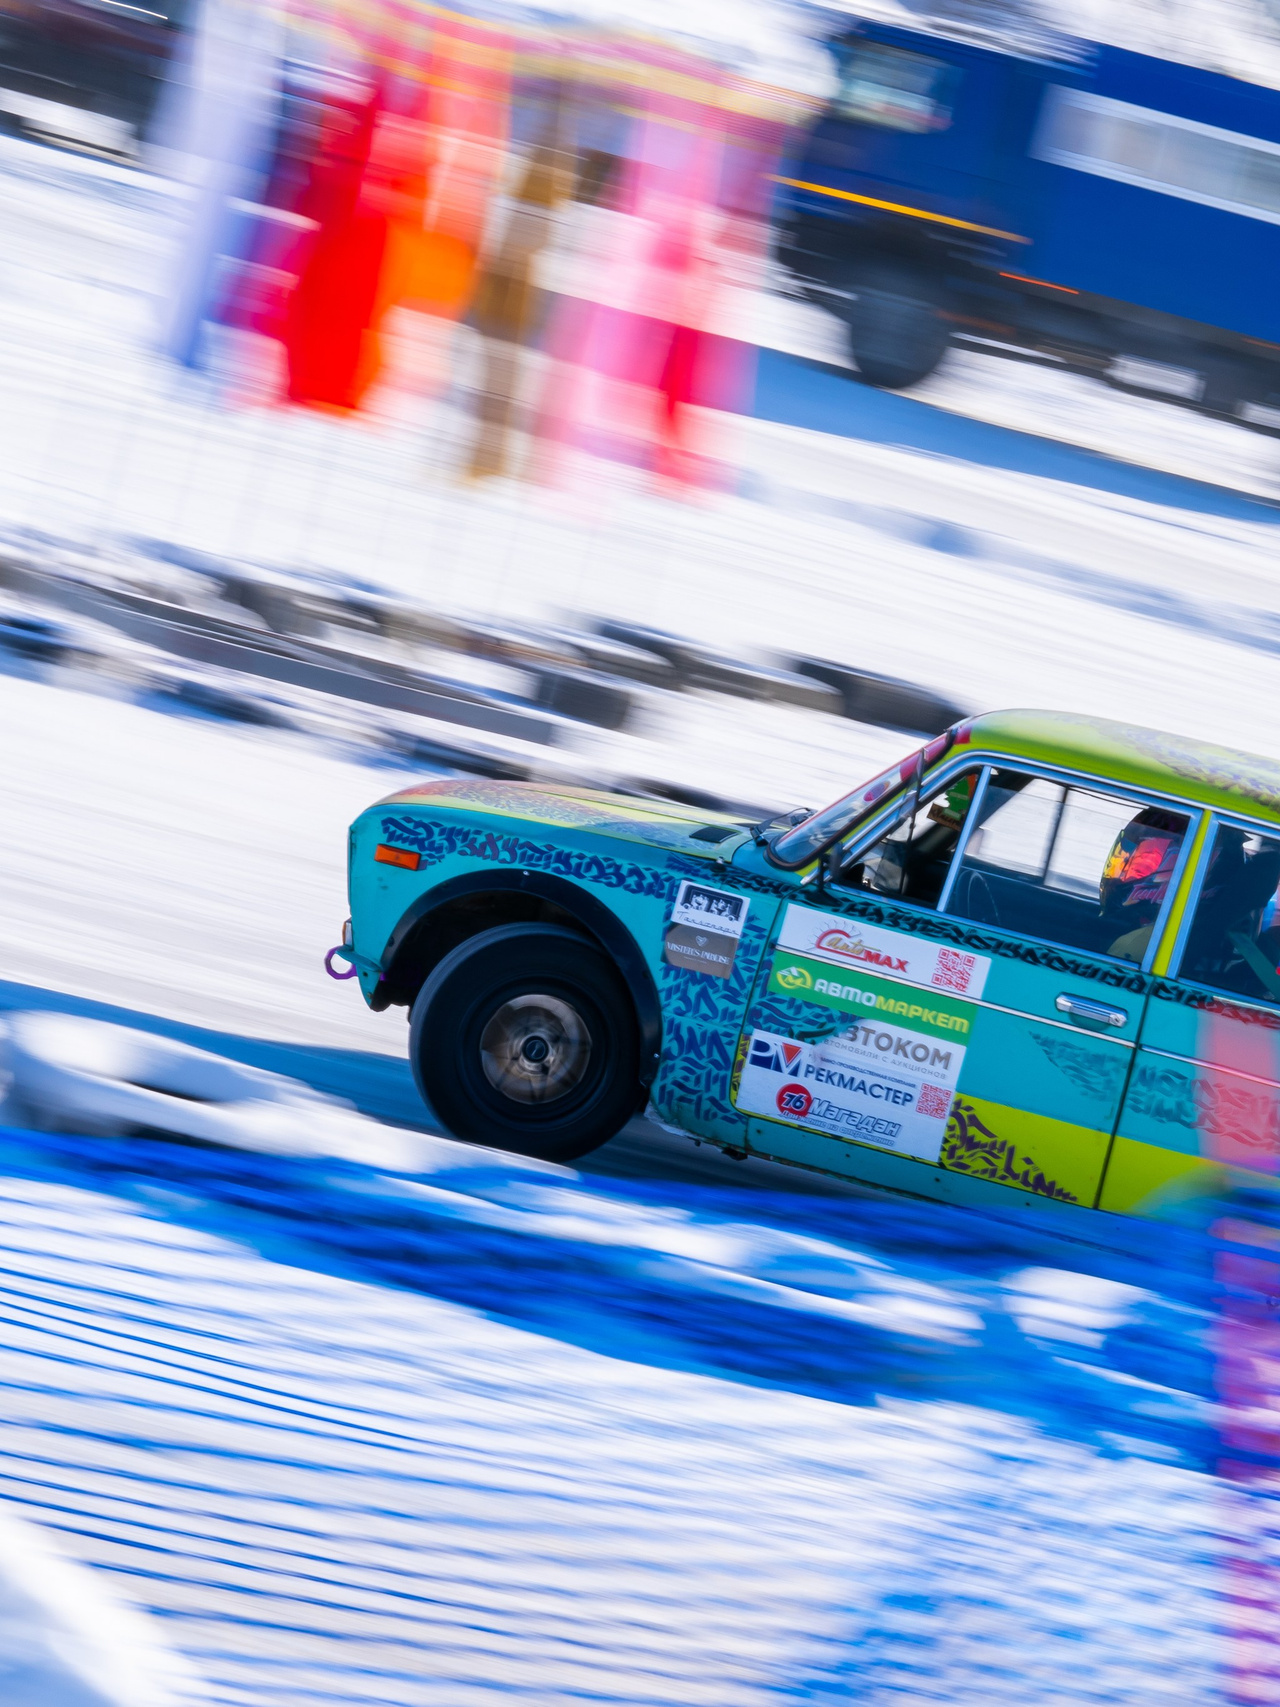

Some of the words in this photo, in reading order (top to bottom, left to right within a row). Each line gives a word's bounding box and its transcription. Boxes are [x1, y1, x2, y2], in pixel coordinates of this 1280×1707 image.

[822, 1038, 879, 1061] ВТОМОБИЛИ
[837, 1024, 954, 1071] ВТОКОМ
[803, 1063, 915, 1108] РЕКМАСТЕР
[783, 1090, 807, 1111] 76
[806, 1097, 902, 1138] Магадан
